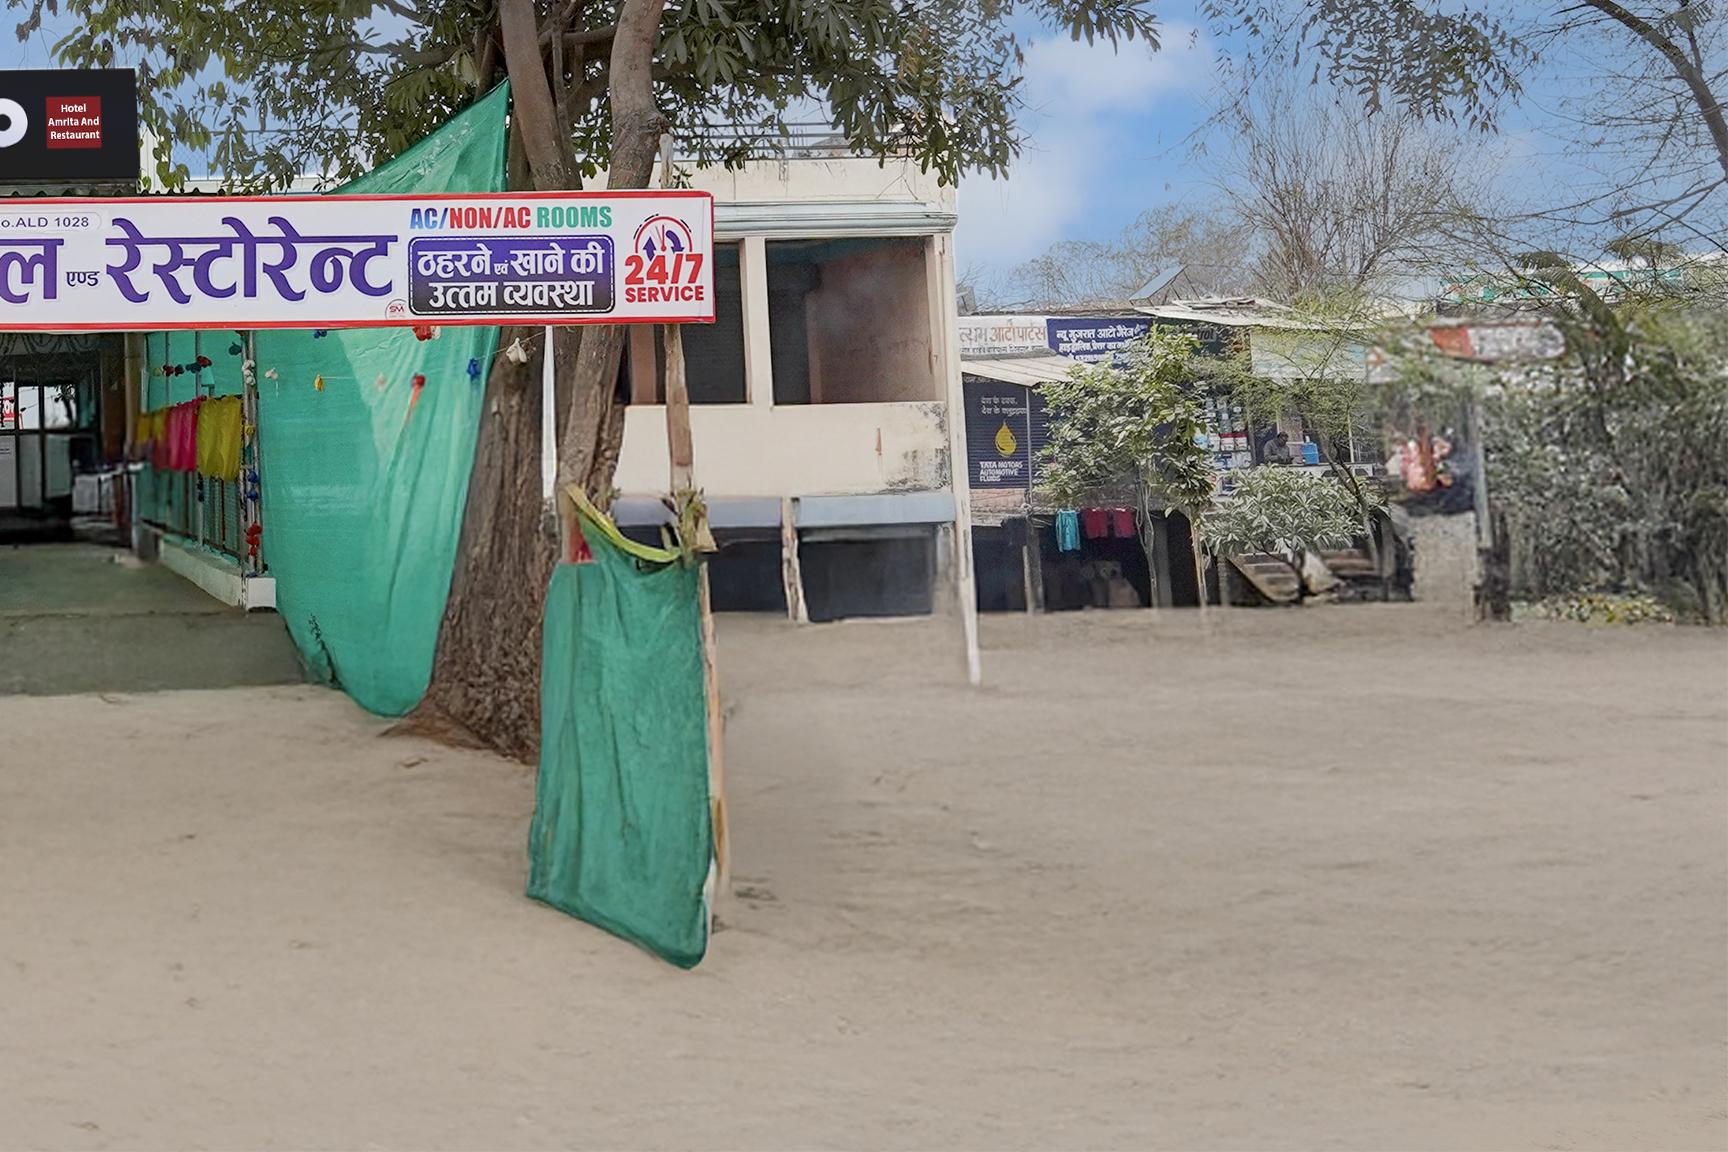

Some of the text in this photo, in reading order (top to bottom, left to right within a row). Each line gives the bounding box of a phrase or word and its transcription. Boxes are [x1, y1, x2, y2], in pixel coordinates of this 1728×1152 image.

[61, 104, 87, 113] Hotel
[48, 116, 100, 126] Amrita And
[51, 130, 100, 140] Restaurant
[54, 217, 89, 228] 1028
[410, 206, 612, 230] AC/NON/AC ROOMS
[66, 270, 100, 288] एण्ड
[106, 216, 399, 305] रेस्टोरेन्ट
[417, 242, 605, 278] ठहरने एवं खाने की
[624, 253, 704, 285] 24/7
[429, 280, 594, 308] उत्तम व्यवस्था
[625, 285, 704, 303] SERVICE
[979, 461, 997, 469] TATA
[980, 468, 1019, 476] AUTOMOTIVE
